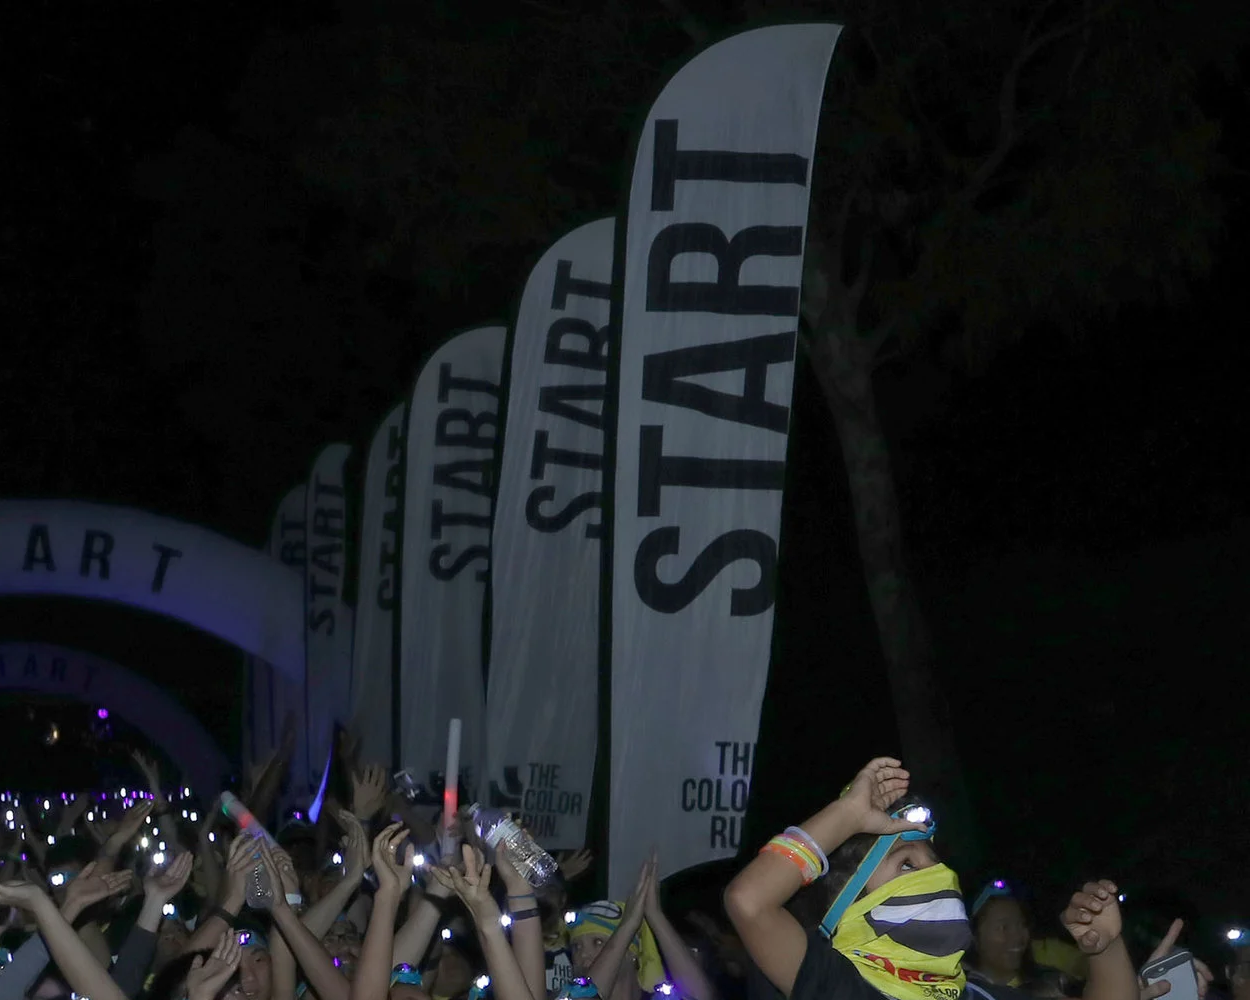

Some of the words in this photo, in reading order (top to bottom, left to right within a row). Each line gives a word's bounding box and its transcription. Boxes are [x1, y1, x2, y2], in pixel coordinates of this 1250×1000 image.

[633, 118, 809, 617] START
[528, 763, 561, 788] THE
[524, 789, 582, 815] COLOR
[682, 779, 750, 812] COLO
